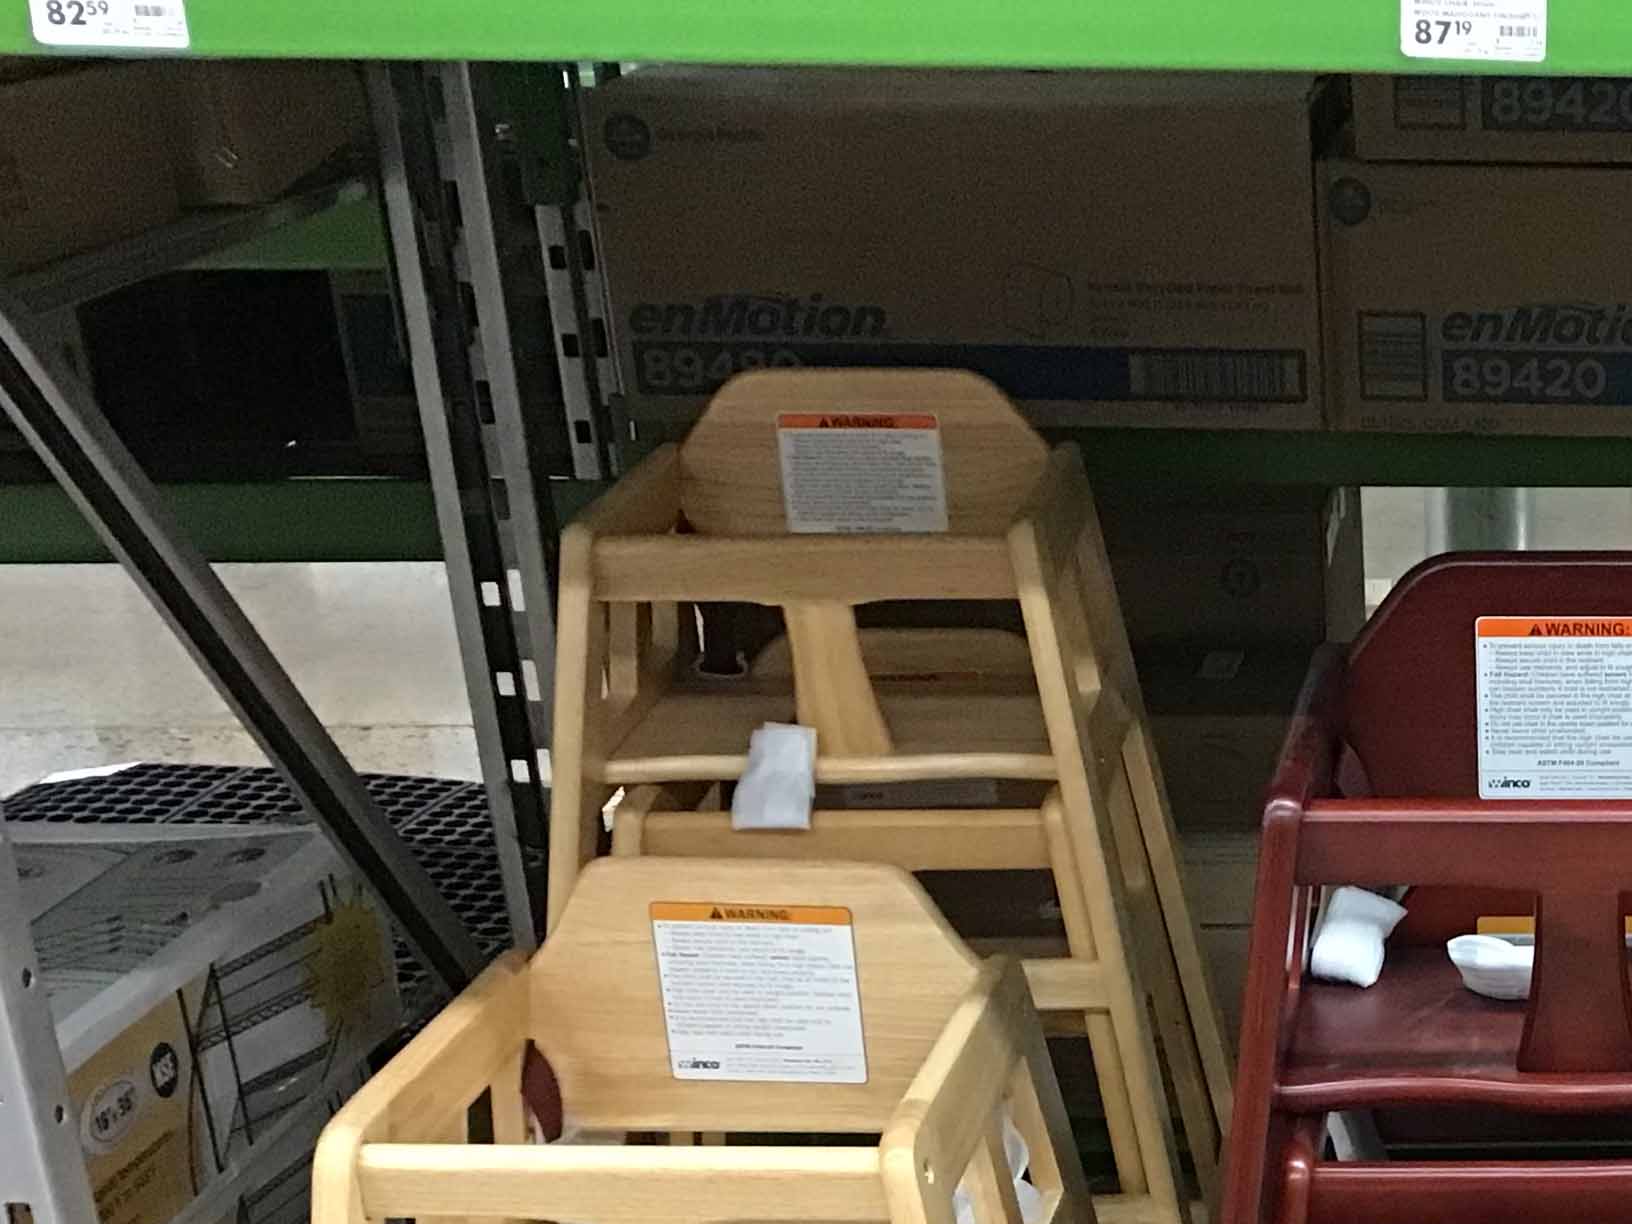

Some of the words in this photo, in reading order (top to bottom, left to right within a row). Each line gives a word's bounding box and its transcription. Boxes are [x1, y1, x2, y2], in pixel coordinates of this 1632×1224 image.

[630, 293, 888, 338] enMotion
[1451, 359, 1606, 398] 89420
[1545, 622, 1630, 636] WARNING:
